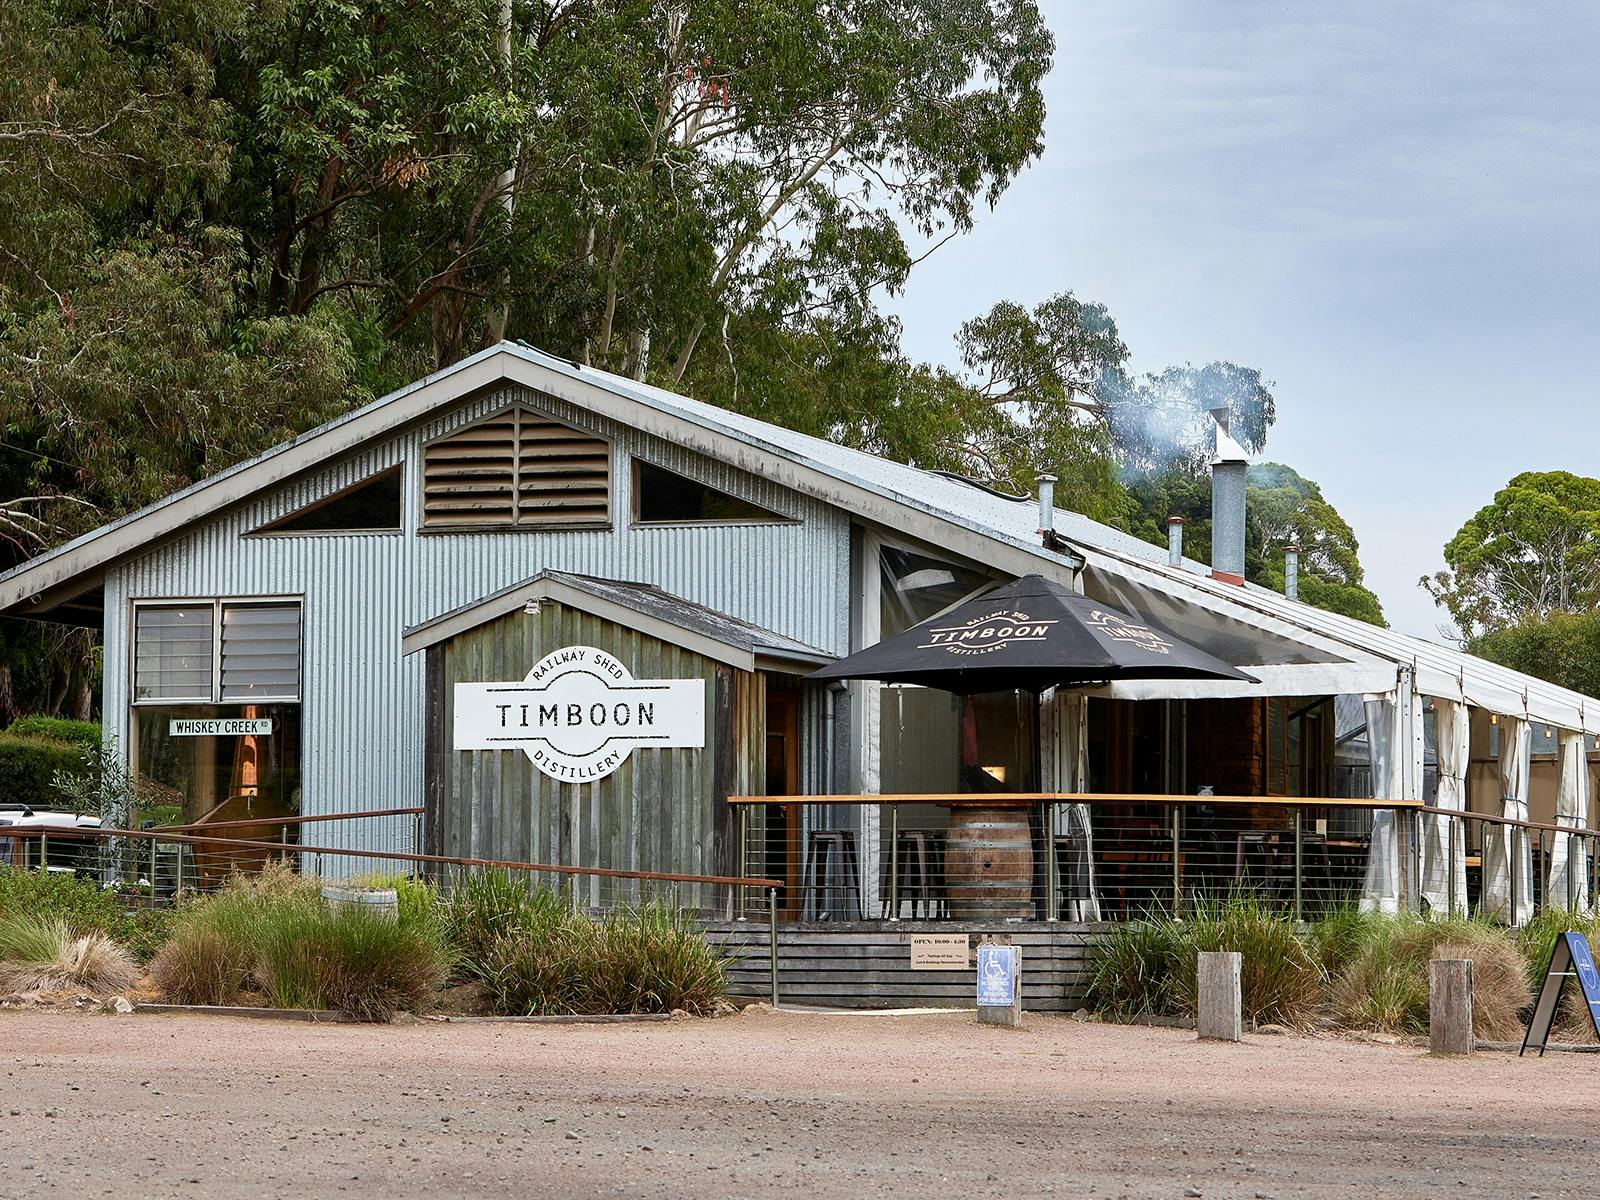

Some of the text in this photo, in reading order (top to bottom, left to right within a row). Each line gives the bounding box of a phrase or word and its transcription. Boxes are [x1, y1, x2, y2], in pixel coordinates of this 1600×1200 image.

[966, 610, 1009, 626] RAILWAY
[930, 625, 1049, 644] TIMBOON
[945, 642, 1007, 655] DISTILLERY
[533, 650, 623, 681] RAILWAY SHED
[496, 702, 654, 727] TIMBOON
[176, 721, 221, 733] WHISKEY
[224, 721, 258, 733] CREEK
[533, 749, 620, 778] DISTILLERY
